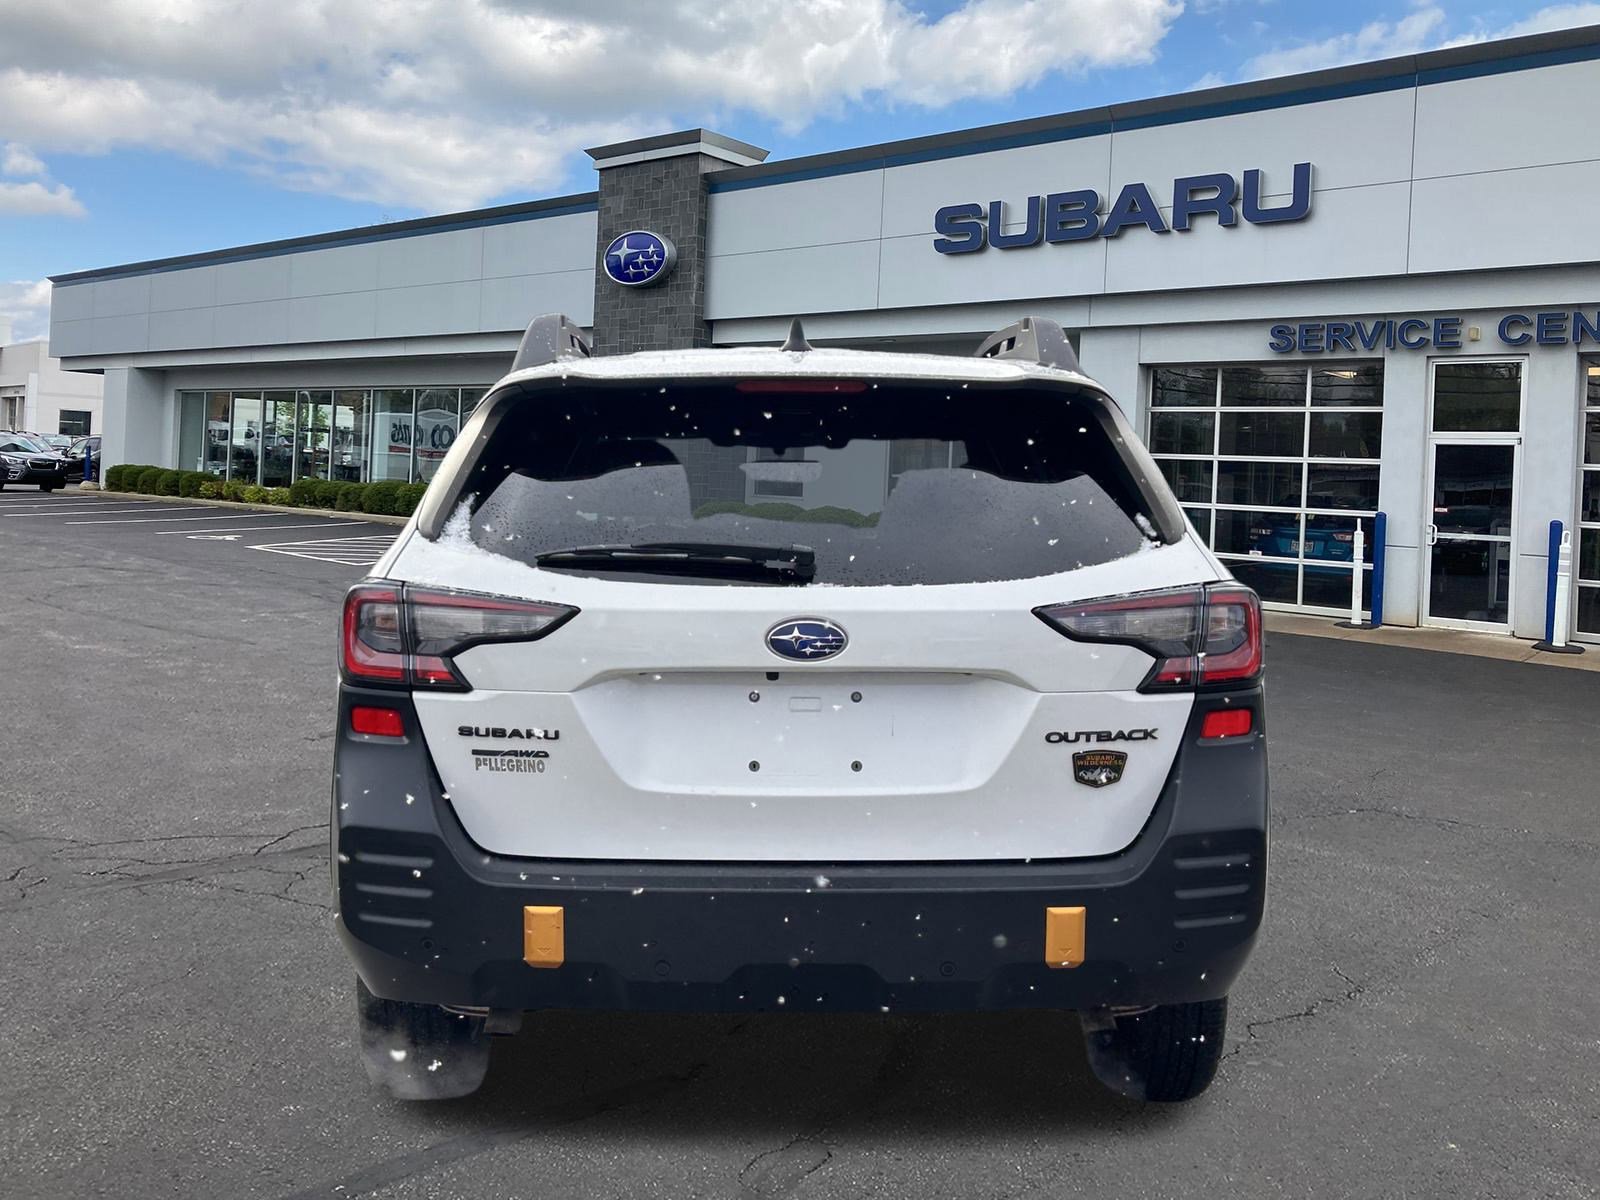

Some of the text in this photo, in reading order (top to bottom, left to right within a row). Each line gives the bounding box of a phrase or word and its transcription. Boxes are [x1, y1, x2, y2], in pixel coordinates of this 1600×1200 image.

[934, 162, 1312, 255] SUBARU
[1269, 311, 1600, 353] SERVICE CEN
[458, 725, 560, 740] SUBARU
[1045, 728, 1159, 743] OUTBACK
[498, 749, 549, 758] AWD
[475, 757, 545, 773] PELLEGRINO
